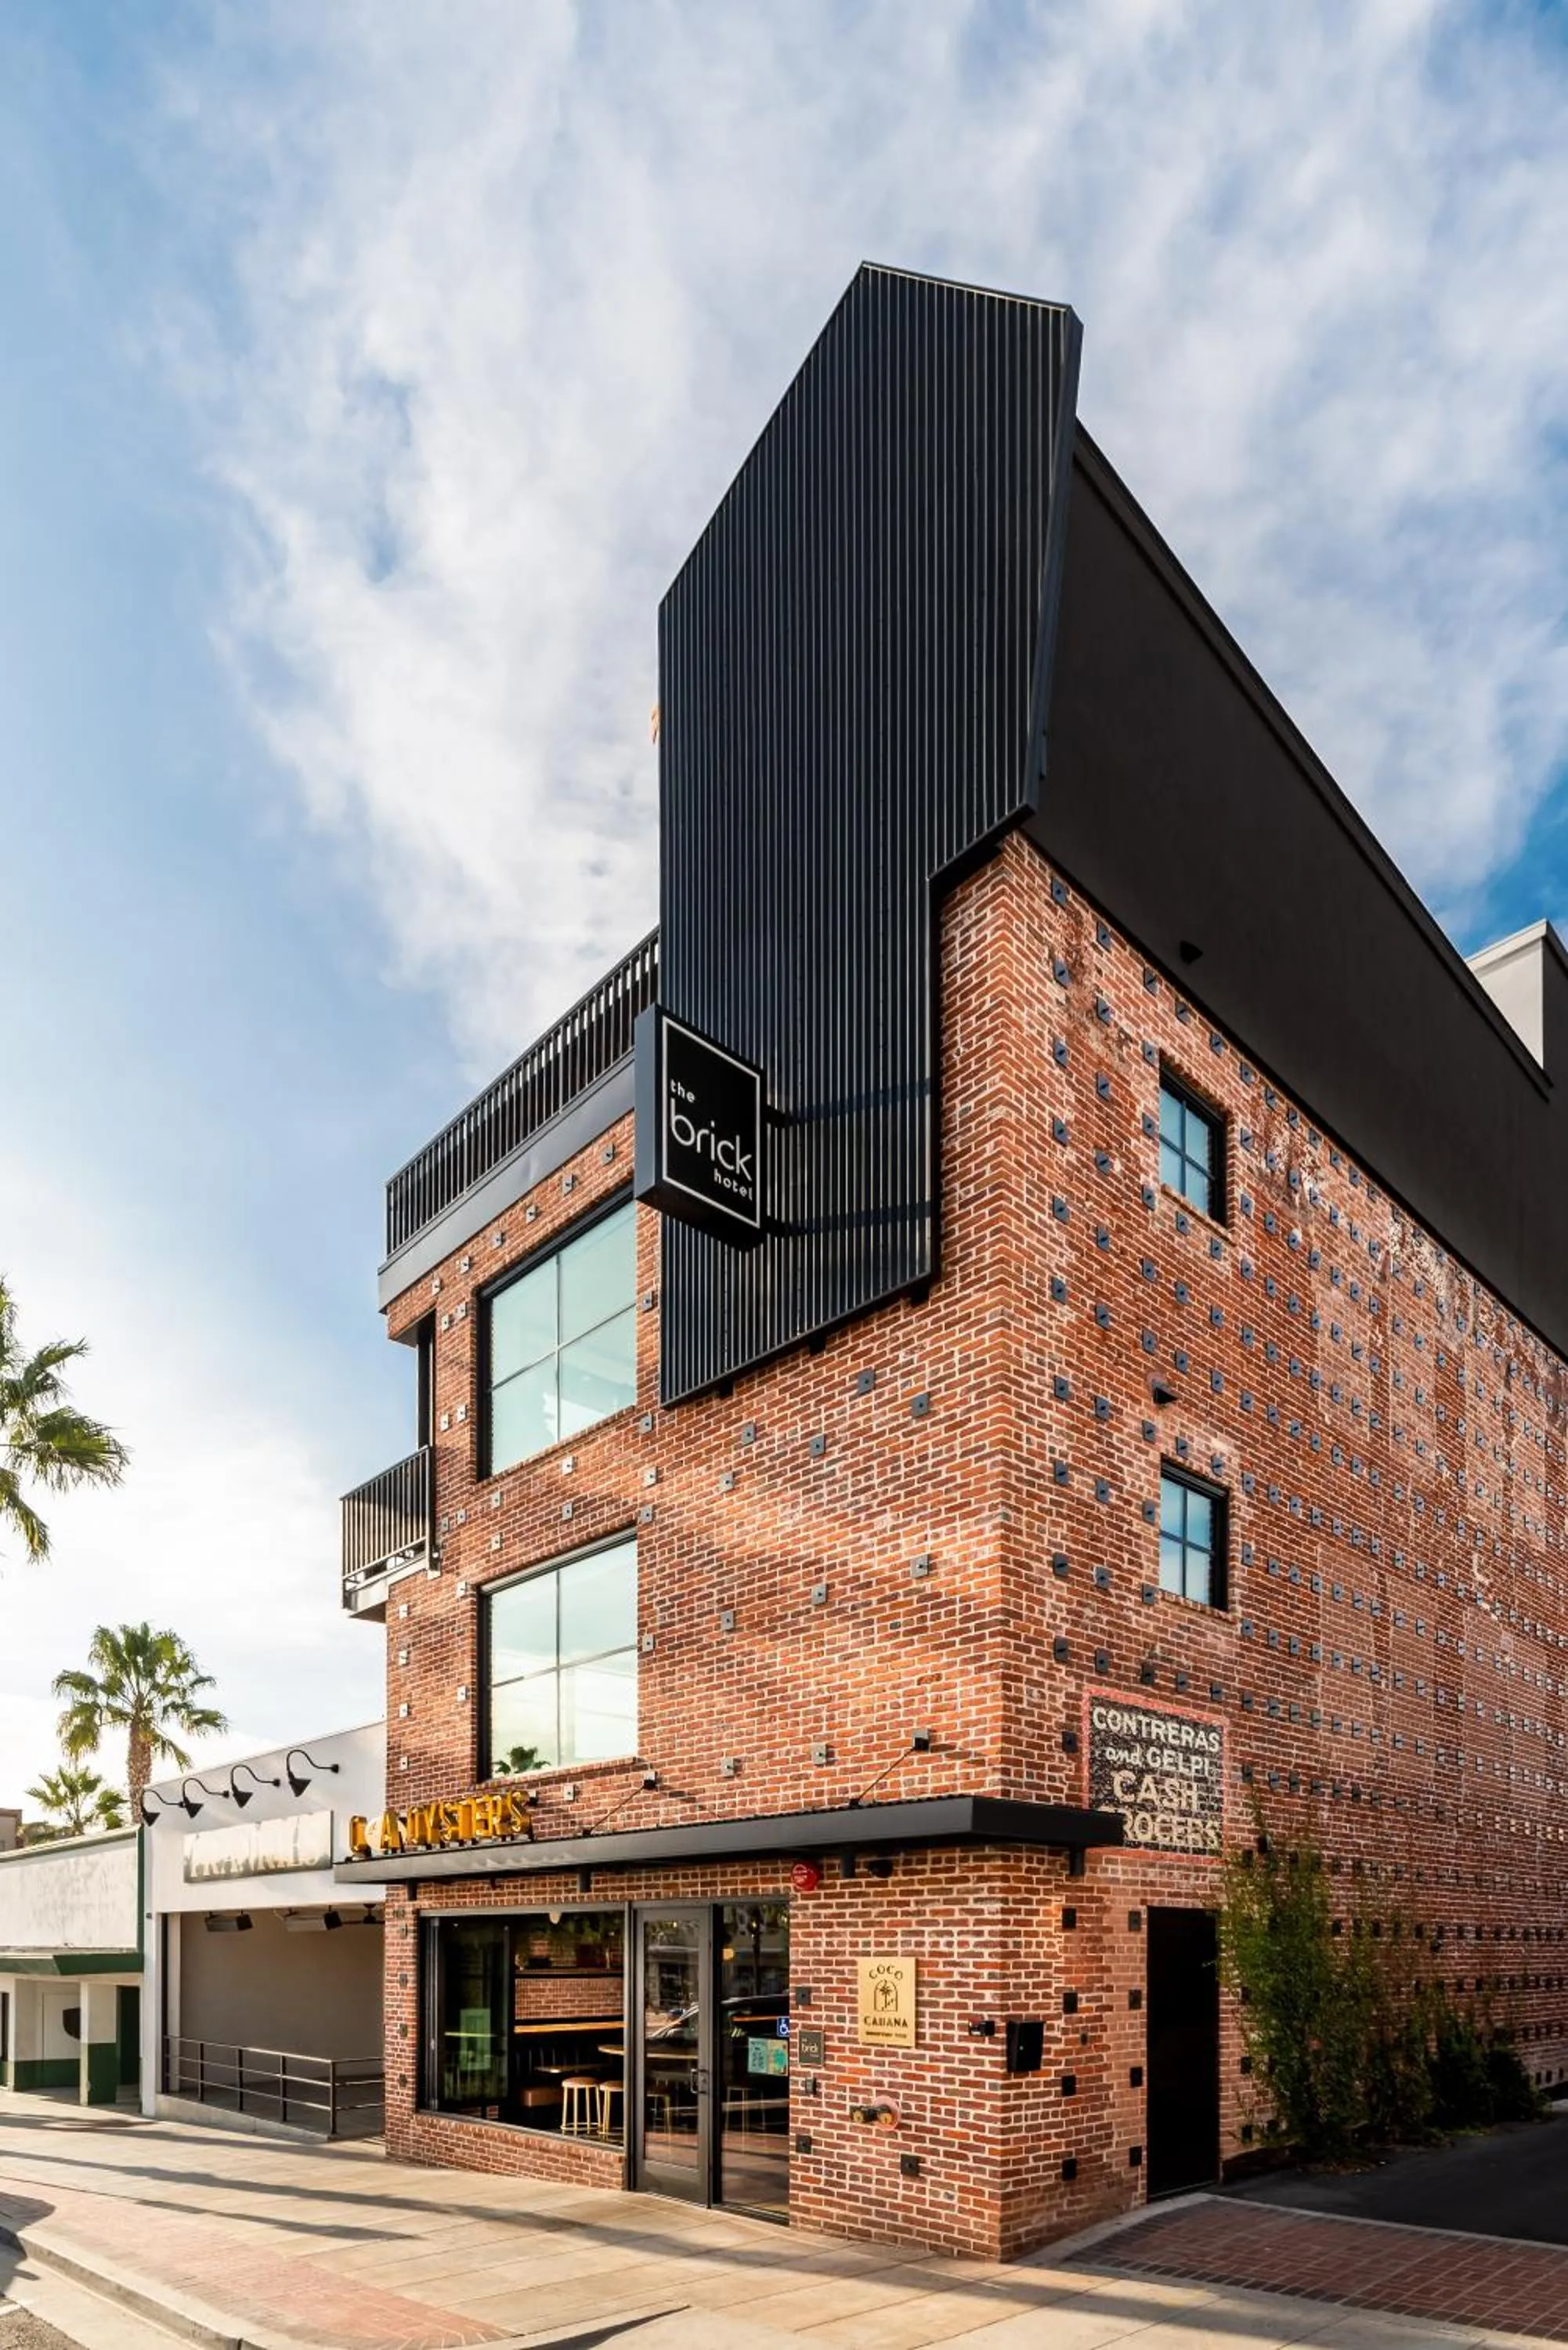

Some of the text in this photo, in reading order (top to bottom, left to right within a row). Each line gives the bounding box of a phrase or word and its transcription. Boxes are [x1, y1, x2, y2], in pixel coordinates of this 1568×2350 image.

[670, 1078, 695, 1103] the
[670, 1097, 753, 1181] brick
[714, 1168, 753, 1201] hotel
[1093, 1705, 1220, 1753] CONTRERAS
[1105, 1742, 1210, 1777] and GELPI
[1112, 1770, 1198, 1813] CASH
[1099, 1804, 1220, 1849] ROCERS
[869, 1964, 903, 1981] COCO
